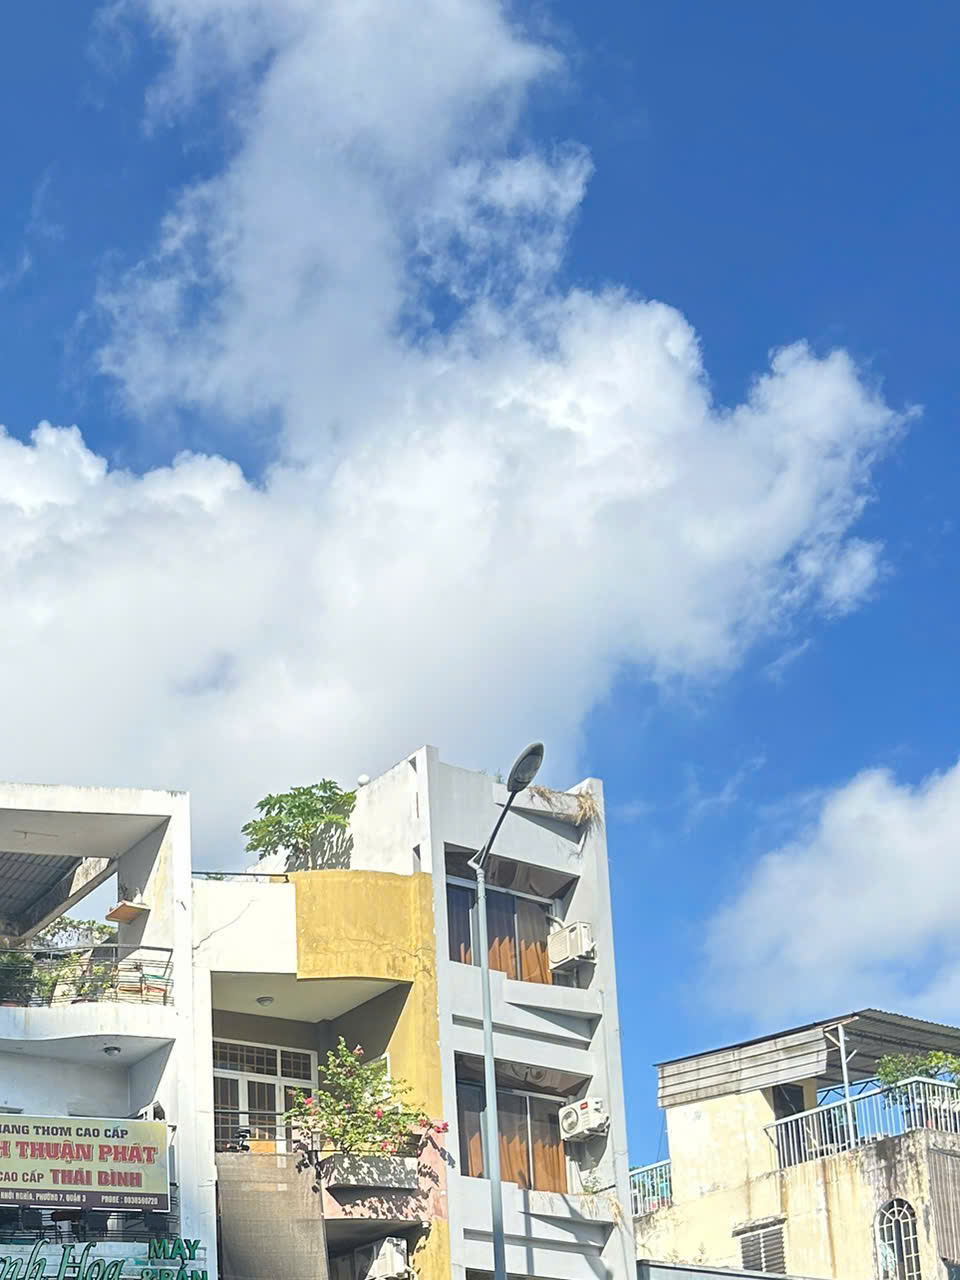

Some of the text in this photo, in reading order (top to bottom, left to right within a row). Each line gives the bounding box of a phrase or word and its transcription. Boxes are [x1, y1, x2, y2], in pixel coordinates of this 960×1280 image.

[33, 1125, 72, 1136] THƠM
[76, 1127, 100, 1138] CAO
[104, 1125, 129, 1139] CẤP
[15, 1140, 94, 1164] THUẬN
[98, 1142, 158, 1165] PHÁT
[22, 1169, 44, 1183] CẤP
[49, 1168, 91, 1186] THÁI
[97, 1169, 143, 1187] BÌNH
